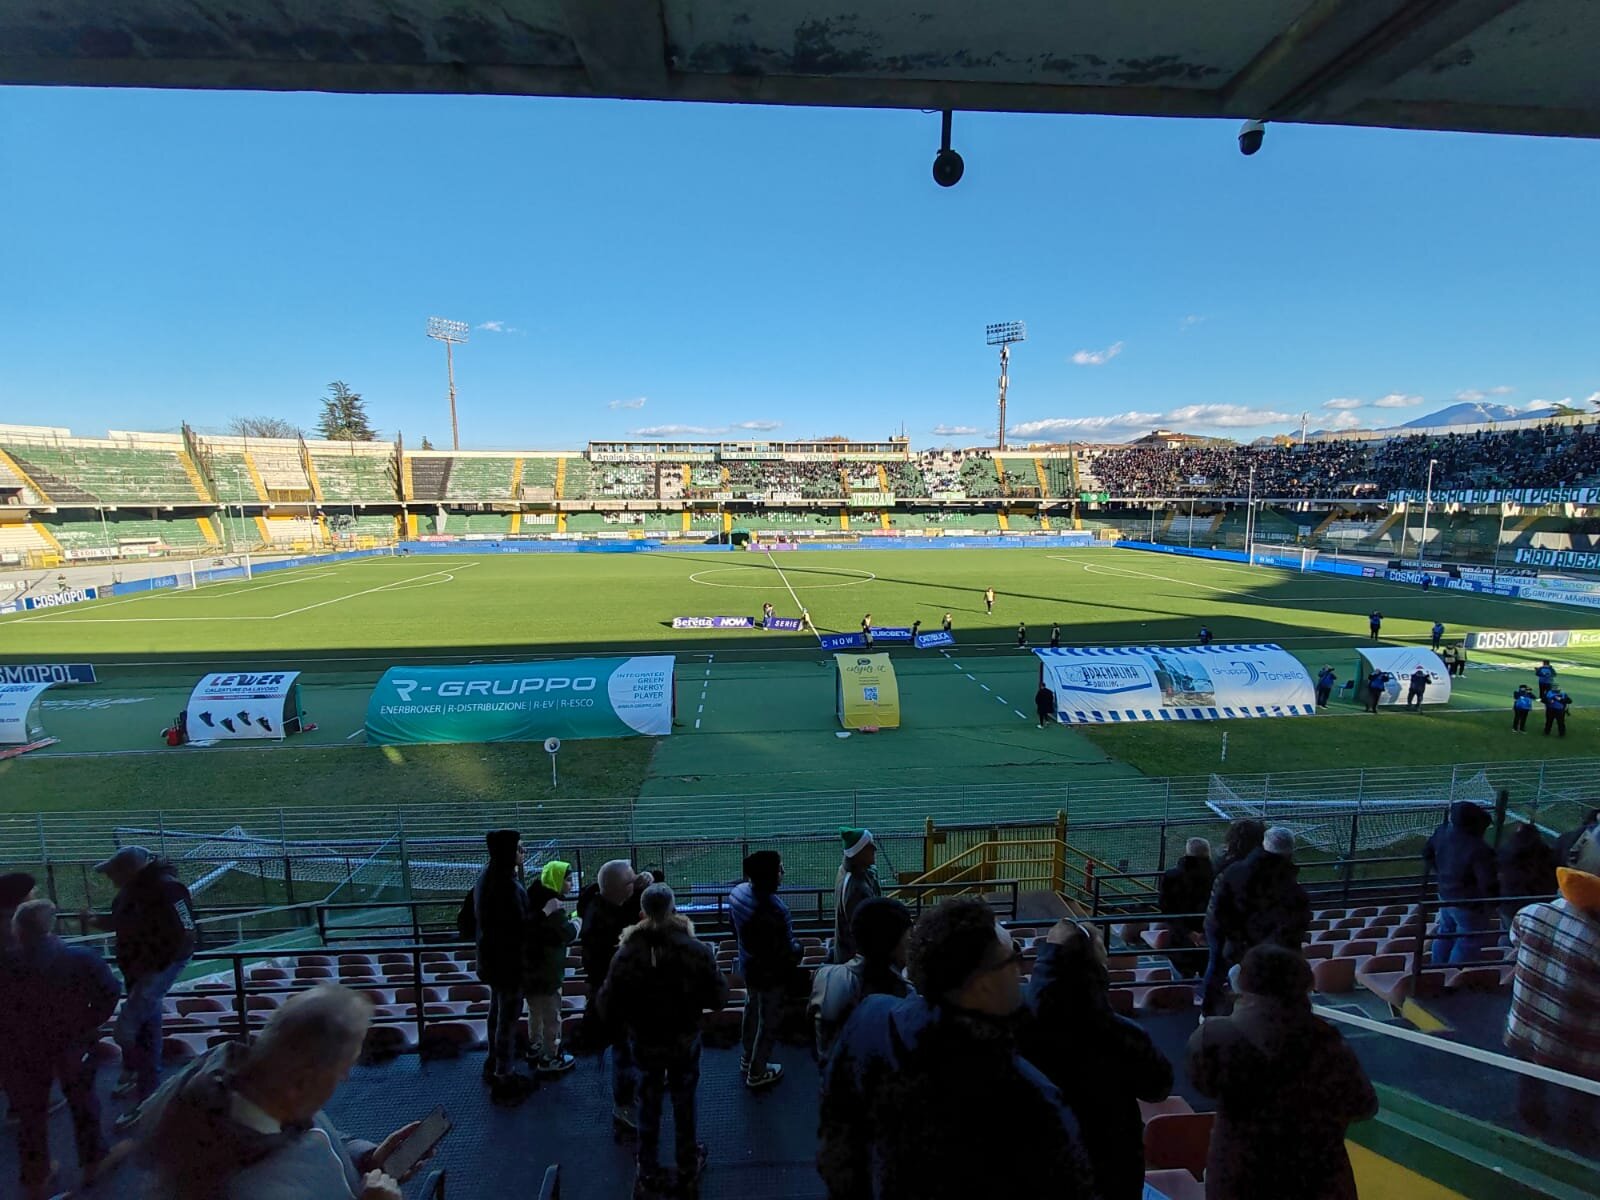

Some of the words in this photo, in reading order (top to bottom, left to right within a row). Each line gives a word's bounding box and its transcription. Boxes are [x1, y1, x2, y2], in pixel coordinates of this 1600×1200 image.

[1531, 489, 1580, 502] PASSO
[1520, 549, 1553, 564] CIAO
[33, 590, 90, 609] COSMOPOL
[720, 618, 748, 627] NOW
[774, 620, 798, 628] SERIE
[832, 637, 853, 646] NOW
[1477, 631, 1557, 648] COSMOPOL
[634, 691, 664, 699] PLAYER
[380, 703, 441, 715] ENERBROKER
[448, 701, 528, 713] R-DISTRIBUZIONE
